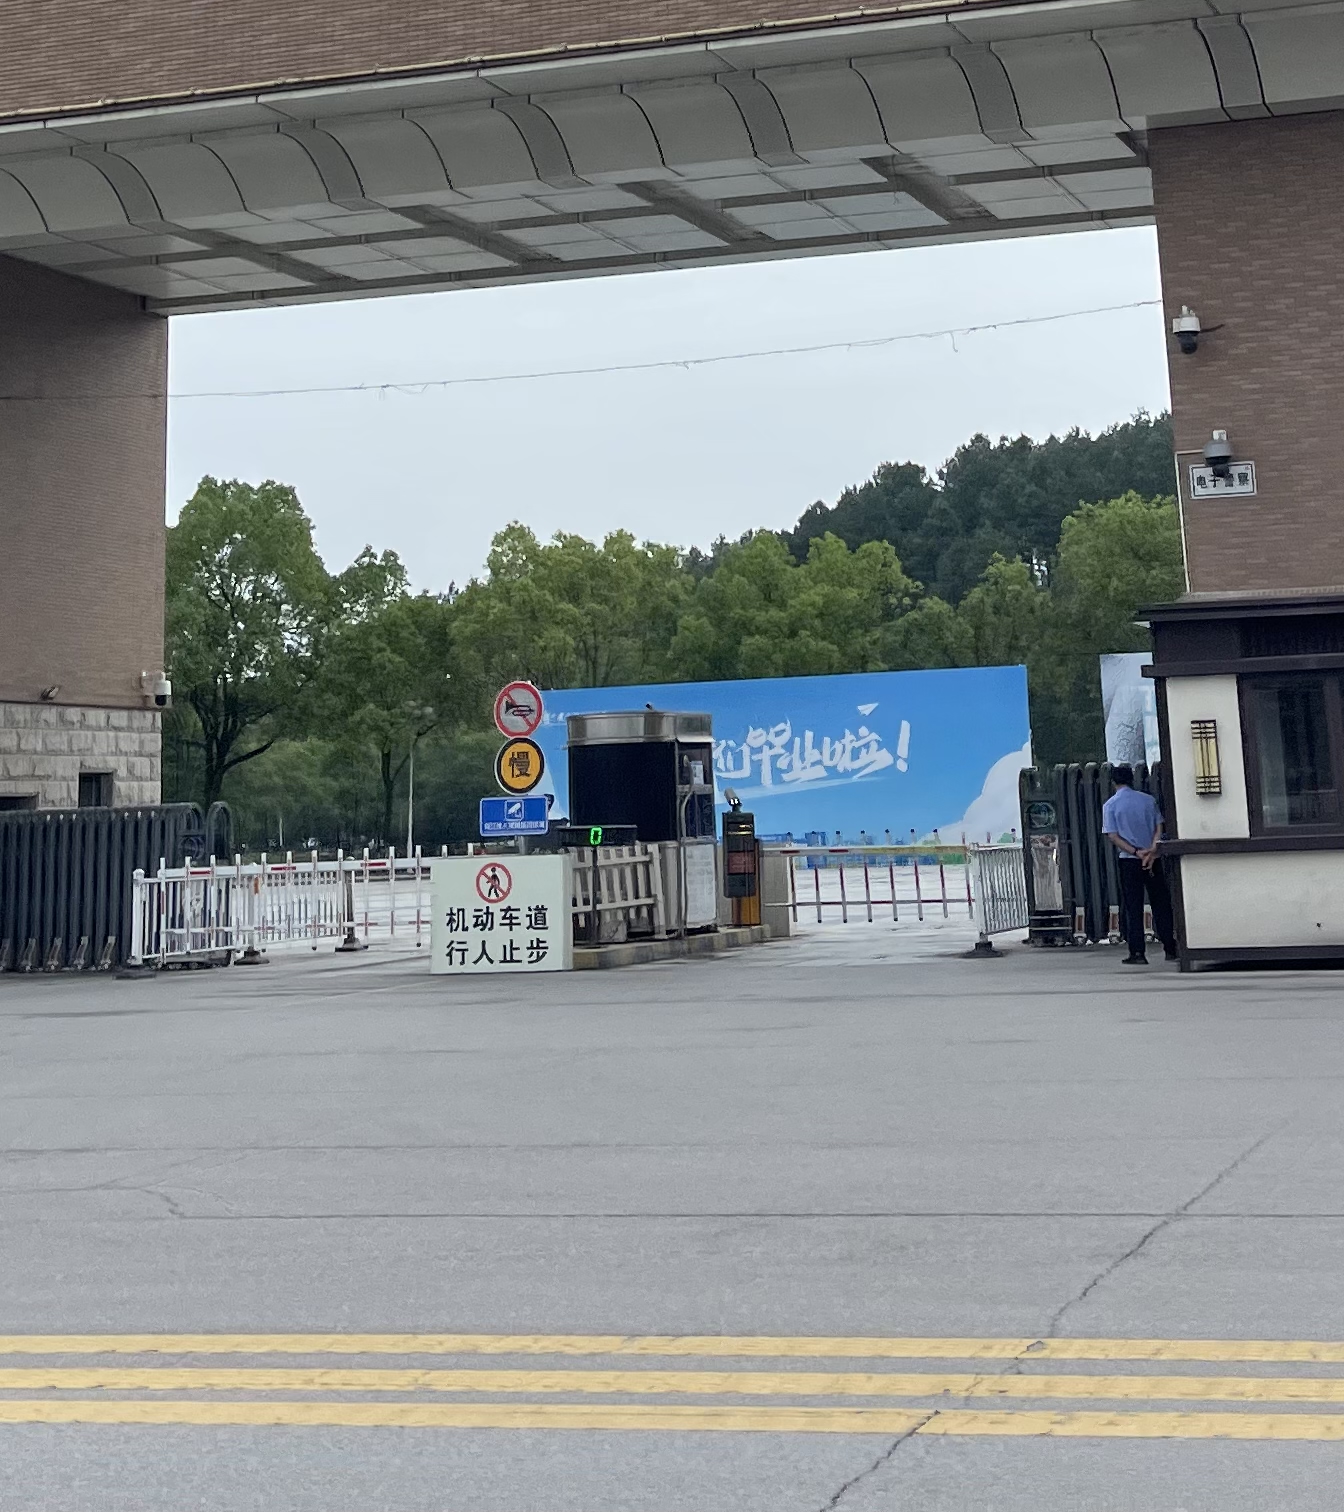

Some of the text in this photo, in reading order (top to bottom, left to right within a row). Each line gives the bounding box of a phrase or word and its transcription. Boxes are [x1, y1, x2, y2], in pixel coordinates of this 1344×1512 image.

[508, 751, 532, 779] 慢
[589, 827, 603, 845] 0
[445, 904, 549, 934] 机动车道
[445, 938, 549, 967] 行人止步
